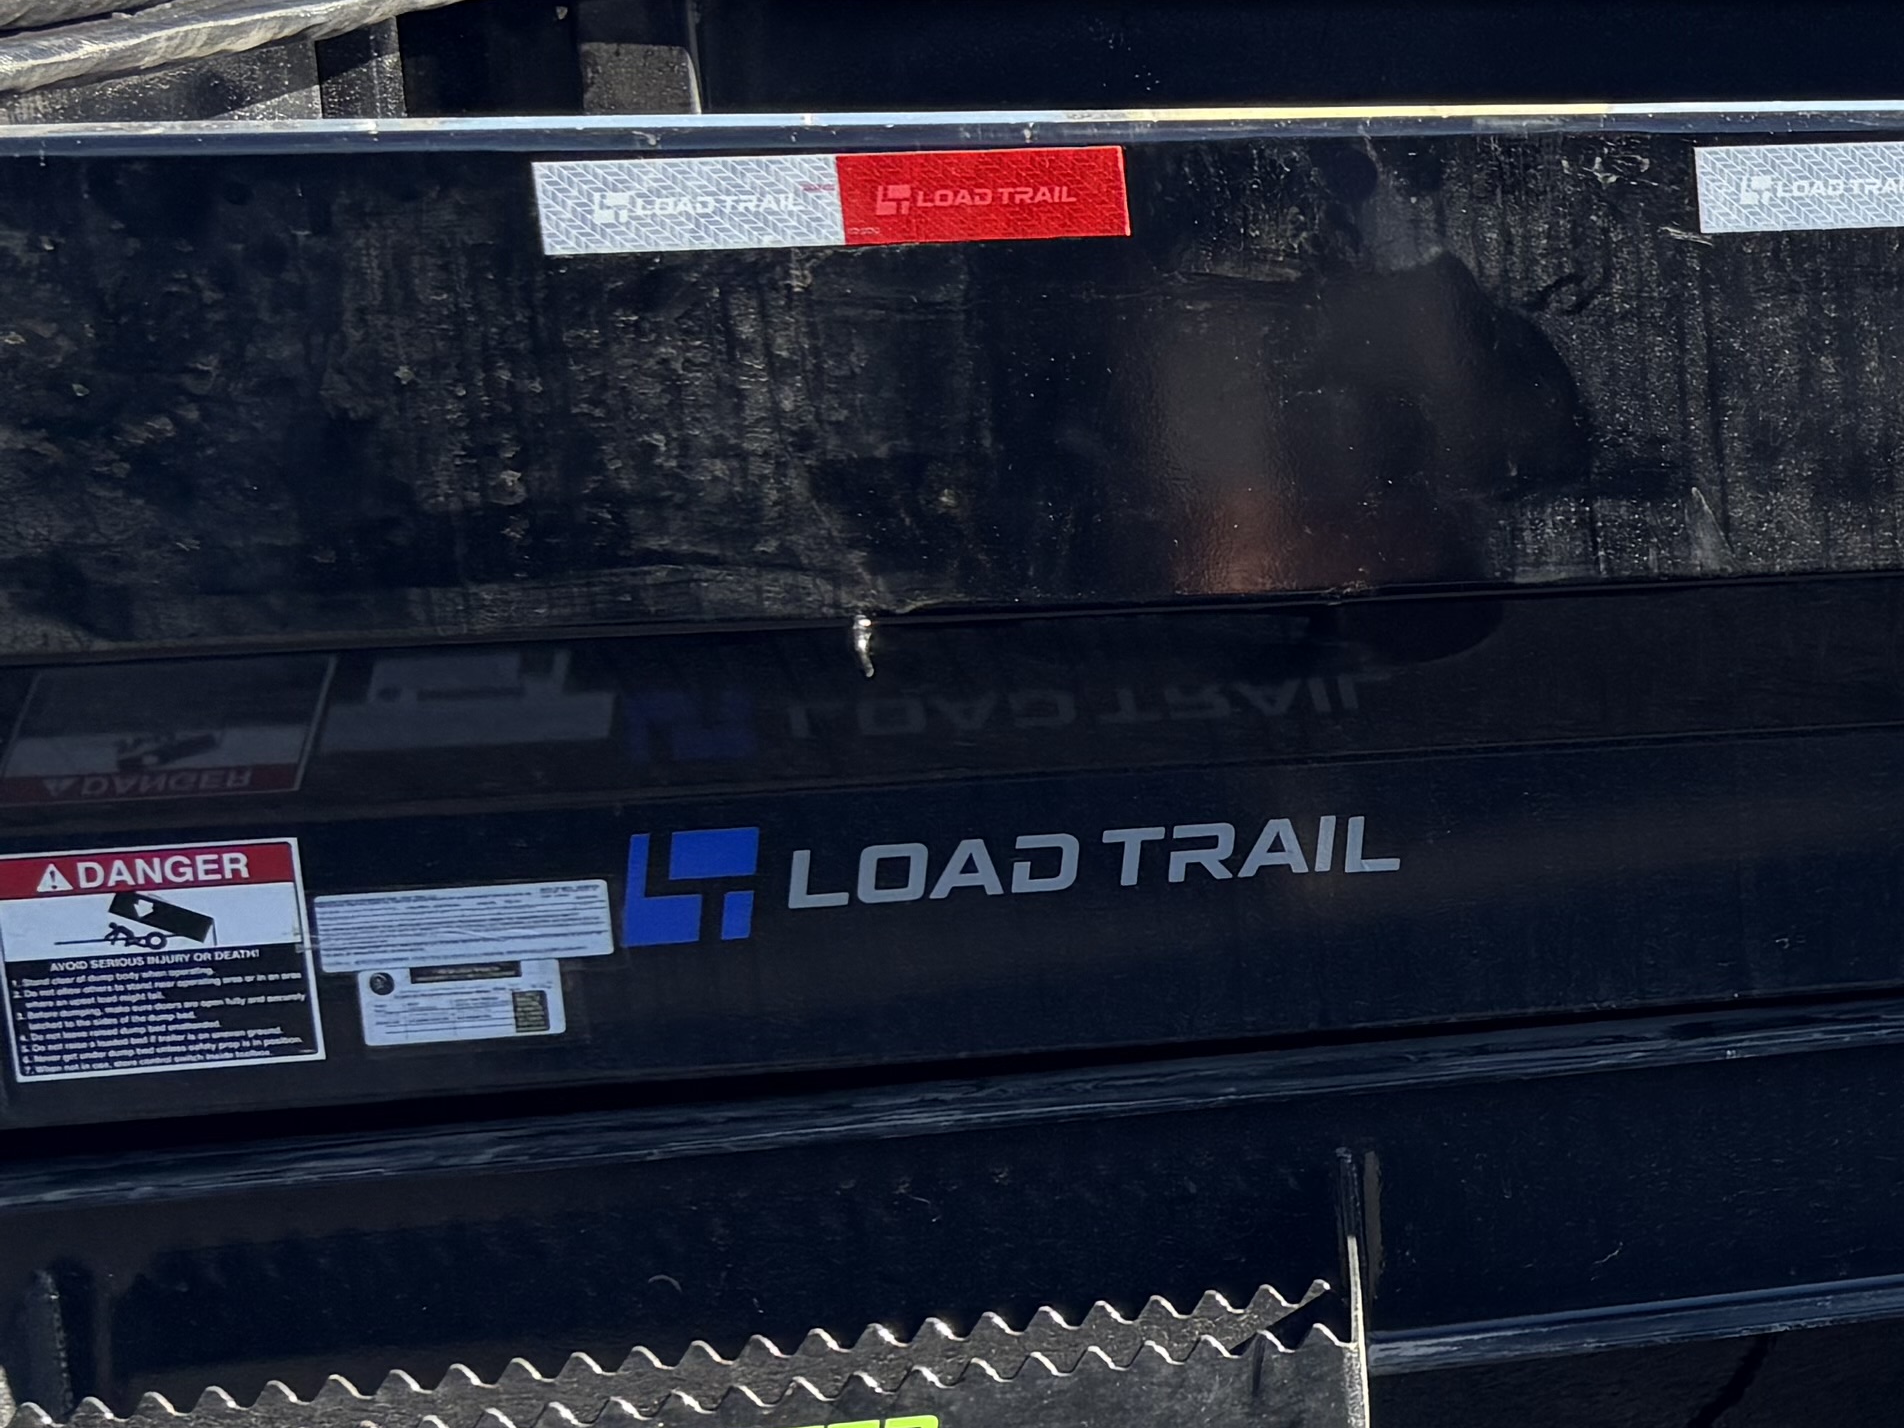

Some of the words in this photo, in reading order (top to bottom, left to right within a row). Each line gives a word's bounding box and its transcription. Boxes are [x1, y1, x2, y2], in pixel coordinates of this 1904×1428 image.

[916, 189, 992, 207] LOAD
[1000, 185, 1078, 204] TRAIL
[76, 852, 250, 889] DANGER
[788, 834, 1079, 909] LOAD
[1101, 814, 1402, 888] TRAIL
